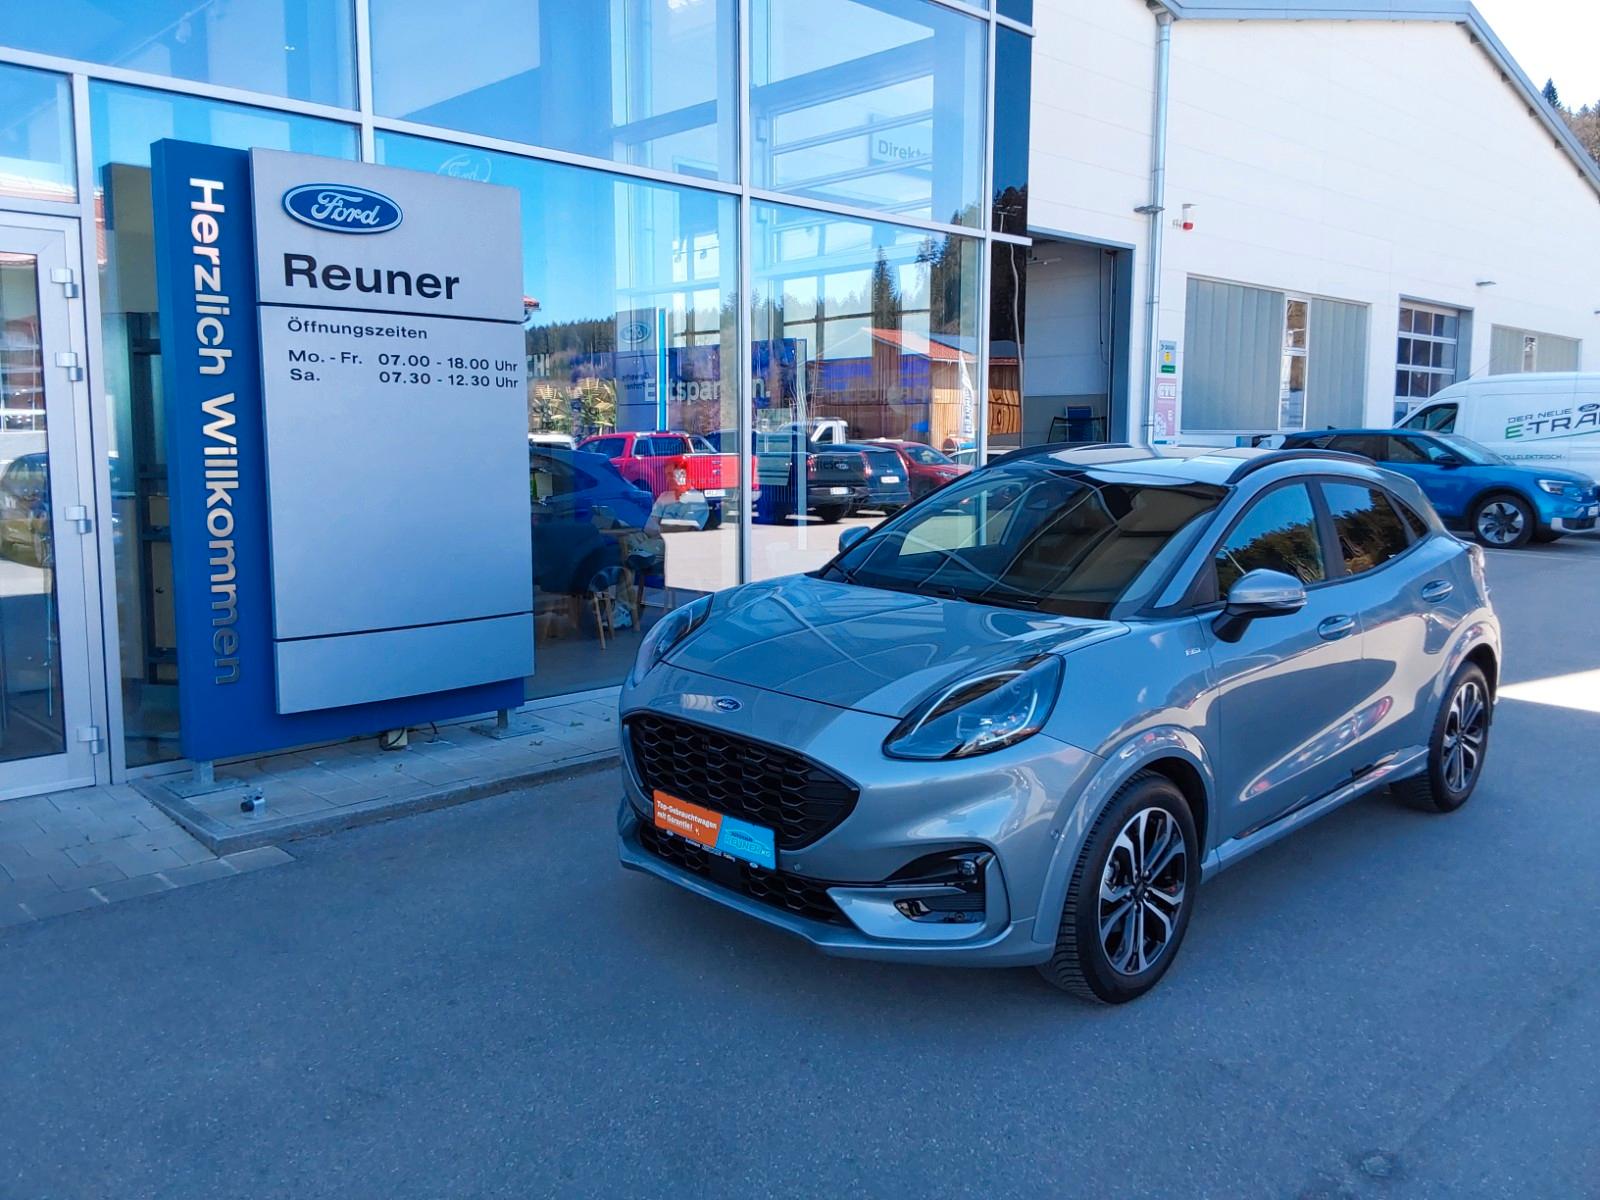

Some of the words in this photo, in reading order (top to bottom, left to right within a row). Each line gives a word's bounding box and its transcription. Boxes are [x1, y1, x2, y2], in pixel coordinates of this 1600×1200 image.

[310, 190, 381, 225] Ford
[189, 177, 233, 376] Herzlich
[283, 252, 460, 300] Reuner
[287, 316, 428, 339] Öffnungszeiten
[378, 353, 431, 368] 07.00
[447, 357, 490, 370] 18.00
[495, 359, 519, 372] Uhr
[289, 368, 321, 382] Sa.
[379, 371, 431, 385] 07.30
[447, 374, 490, 388] 12.30
[495, 376, 519, 389] Uhr
[1505, 412, 1600, 440] E-TRA
[1508, 414, 1534, 423] DER
[1537, 408, 1573, 419] NEUE
[201, 392, 241, 685] Willkommen
